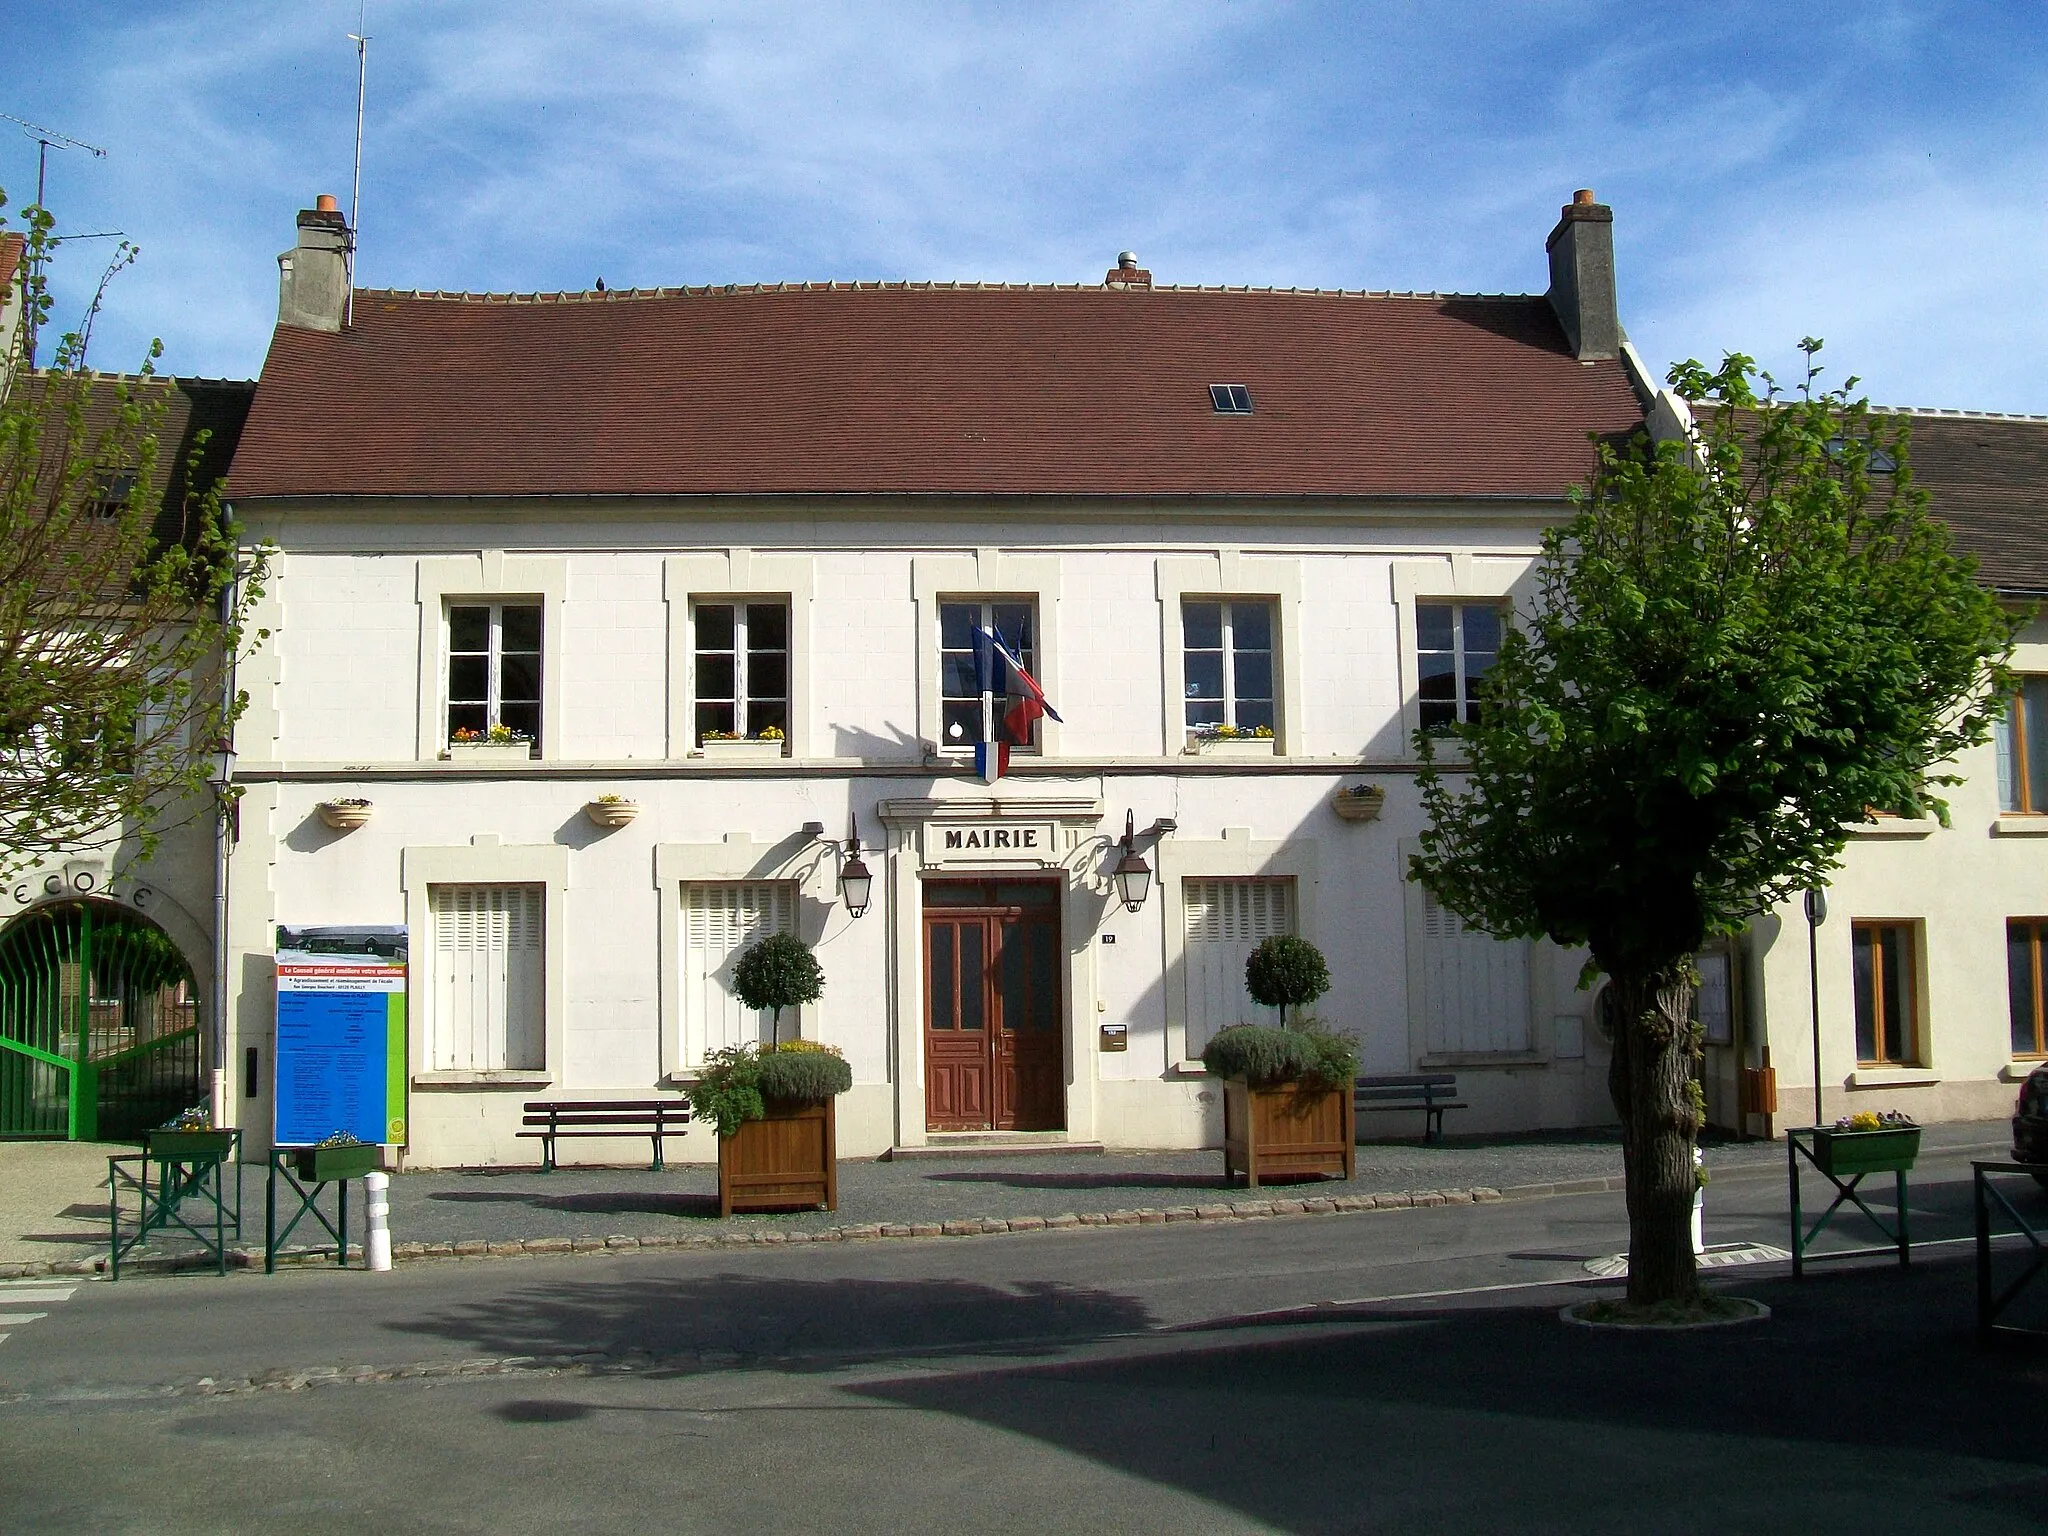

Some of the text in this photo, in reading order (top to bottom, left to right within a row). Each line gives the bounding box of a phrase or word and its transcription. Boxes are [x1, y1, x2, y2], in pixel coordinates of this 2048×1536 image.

[945, 830, 1038, 849] MAIRIE
[1105, 935, 1114, 943] 19
[284, 966, 292, 974] Le
[293, 966, 313, 974] Conseil
[361, 967, 376, 975] votre
[377, 967, 403, 976] quotidien
